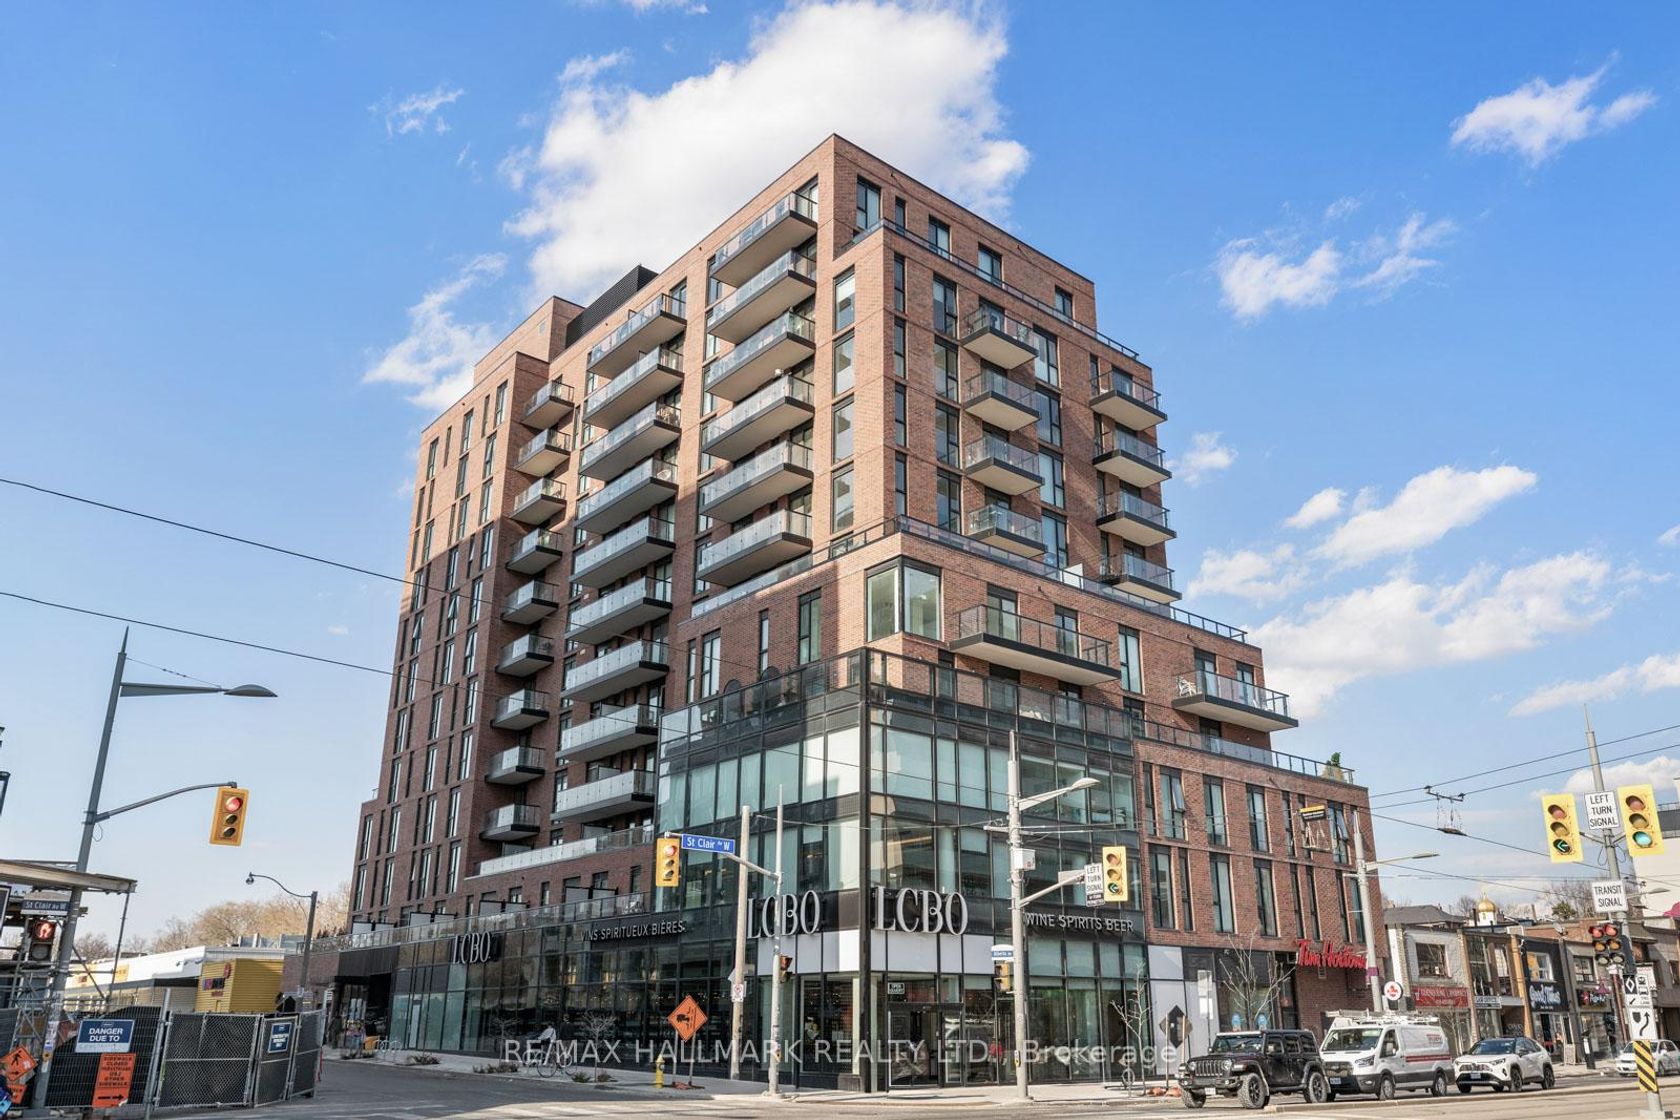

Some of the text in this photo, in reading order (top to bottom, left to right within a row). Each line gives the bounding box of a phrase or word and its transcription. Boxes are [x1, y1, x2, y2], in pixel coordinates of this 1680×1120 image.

[1589, 794, 1610, 805] LEFT
[1591, 807, 1613, 816] TURN
[1589, 817, 1618, 828] SIGNAL
[687, 837, 695, 847] St
[697, 838, 716, 849] Clair
[723, 841, 731, 851] W
[1087, 865, 1100, 874] LEFT
[1087, 875, 1101, 883] TURN
[1593, 885, 1622, 895] TRANSIT
[25, 901, 33, 909] St
[1597, 898, 1623, 908] SIGNAL
[747, 889, 821, 939] LCBO
[874, 885, 969, 936] LCBO
[1024, 911, 1135, 932] WINE SPIRITS BEER
[581, 920, 683, 941] VINS SPIRITUEUX BIÈRES
[453, 931, 491, 964] LCBO
[1297, 939, 1367, 969] Tim Hortons
